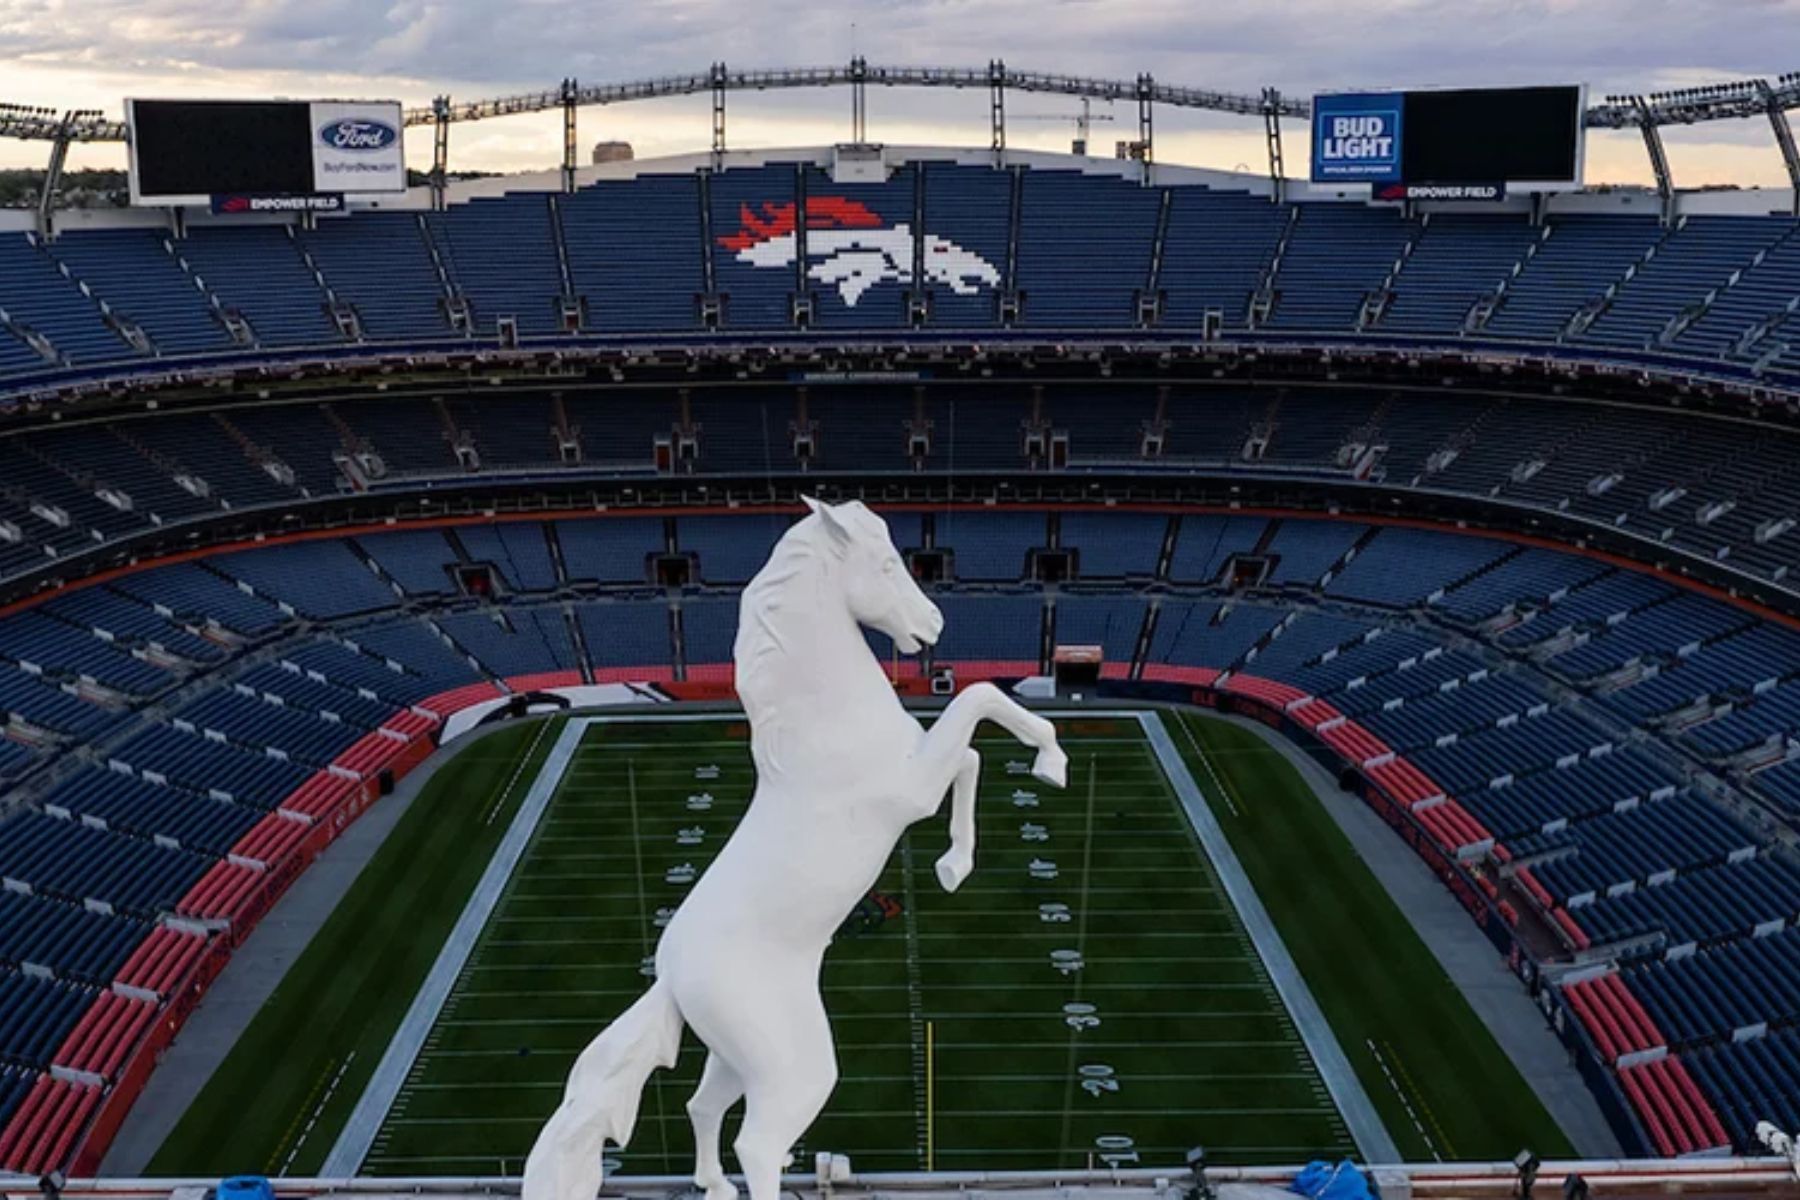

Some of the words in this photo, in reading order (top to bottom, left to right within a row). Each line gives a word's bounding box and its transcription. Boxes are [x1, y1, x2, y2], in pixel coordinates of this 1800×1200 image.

[333, 123, 383, 146] Ford
[1333, 117, 1383, 138] BUD
[1324, 137, 1392, 158] LIGHT
[251, 198, 306, 209] EMPOWER
[307, 197, 338, 208] FIELD
[1407, 186, 1461, 198] EMPOWER
[1464, 186, 1497, 198] FIELD
[1063, 1003, 1099, 1026] 30
[1079, 1065, 1119, 1091] 20
[1096, 1136, 1139, 1162] 10
